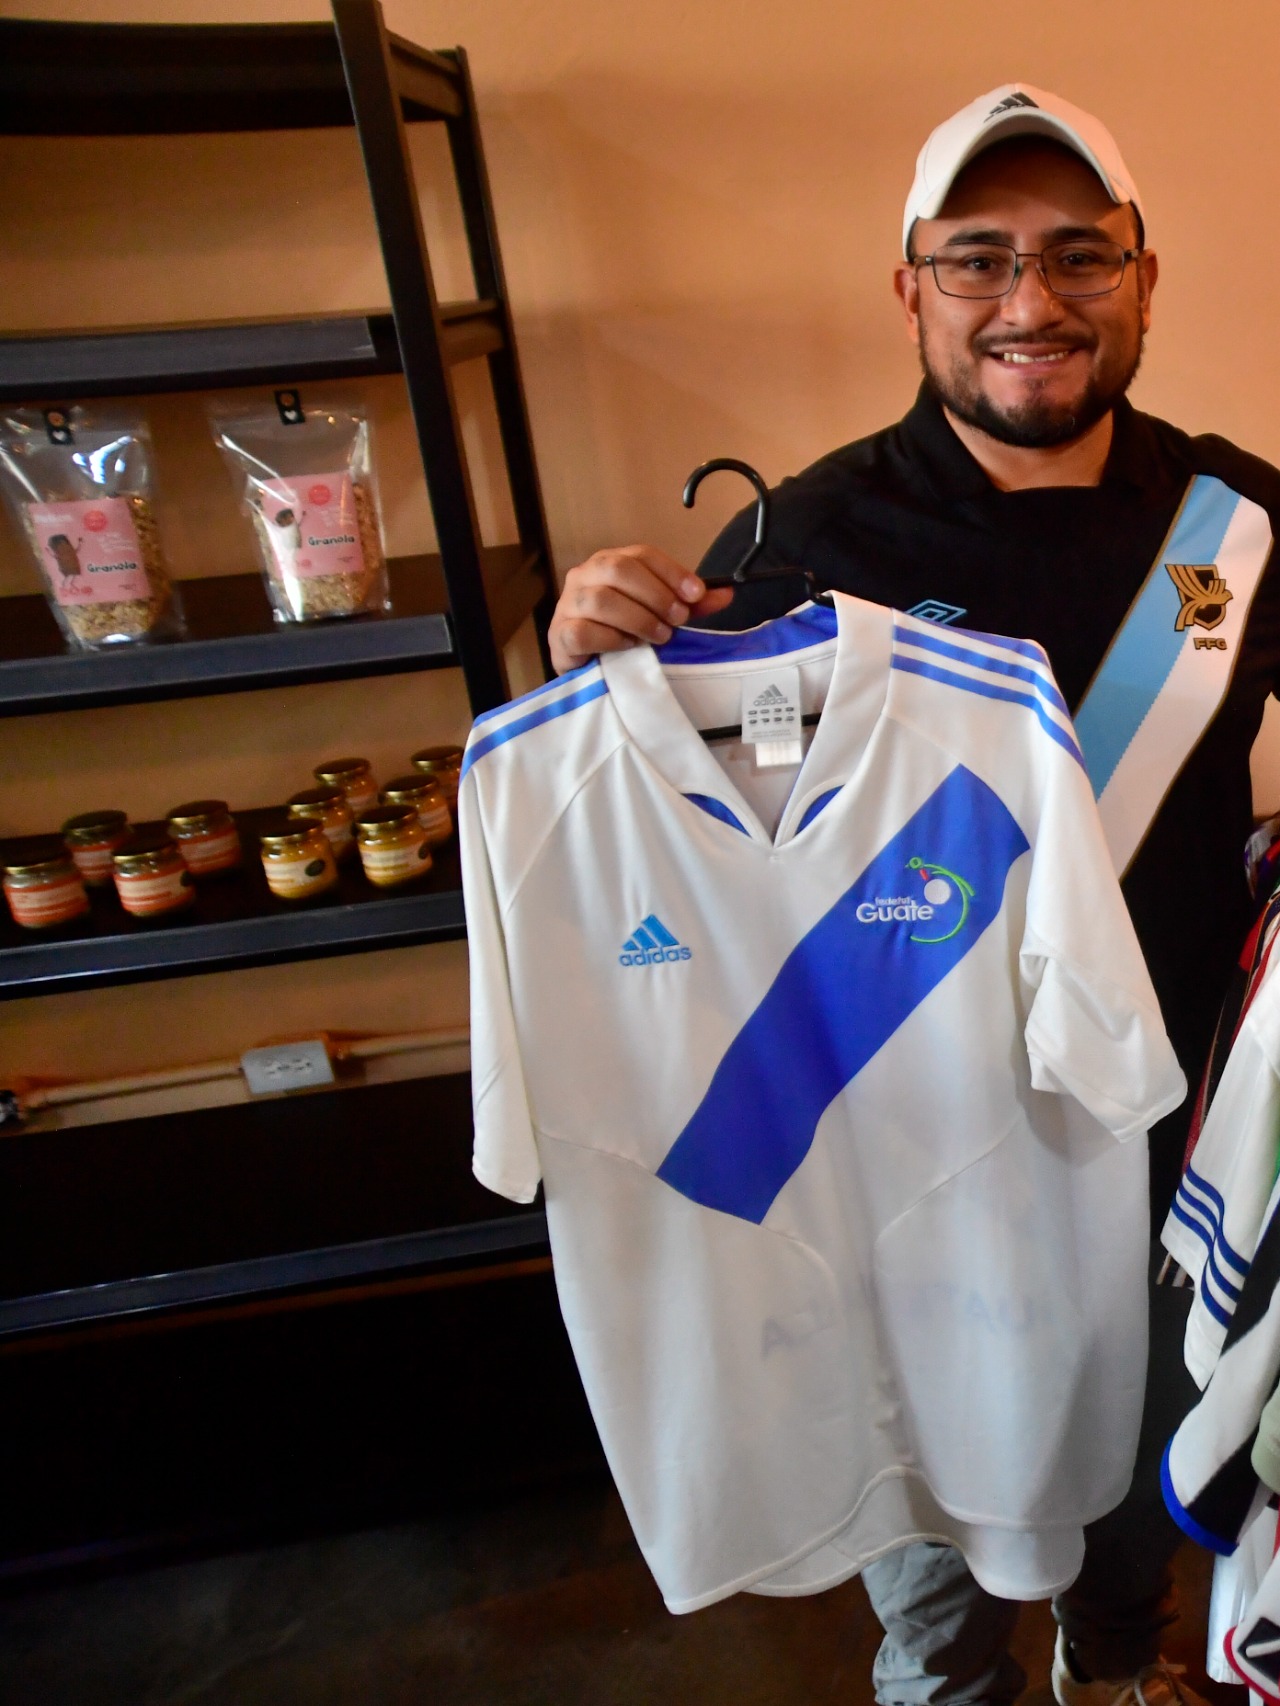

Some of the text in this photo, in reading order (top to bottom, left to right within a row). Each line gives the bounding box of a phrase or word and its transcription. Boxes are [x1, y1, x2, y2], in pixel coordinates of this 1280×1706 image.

[307, 534, 355, 546] Granola
[87, 561, 137, 573] Granola
[1193, 637, 1228, 650] FFG
[856, 900, 934, 923] Guate
[619, 946, 692, 966] adidas
